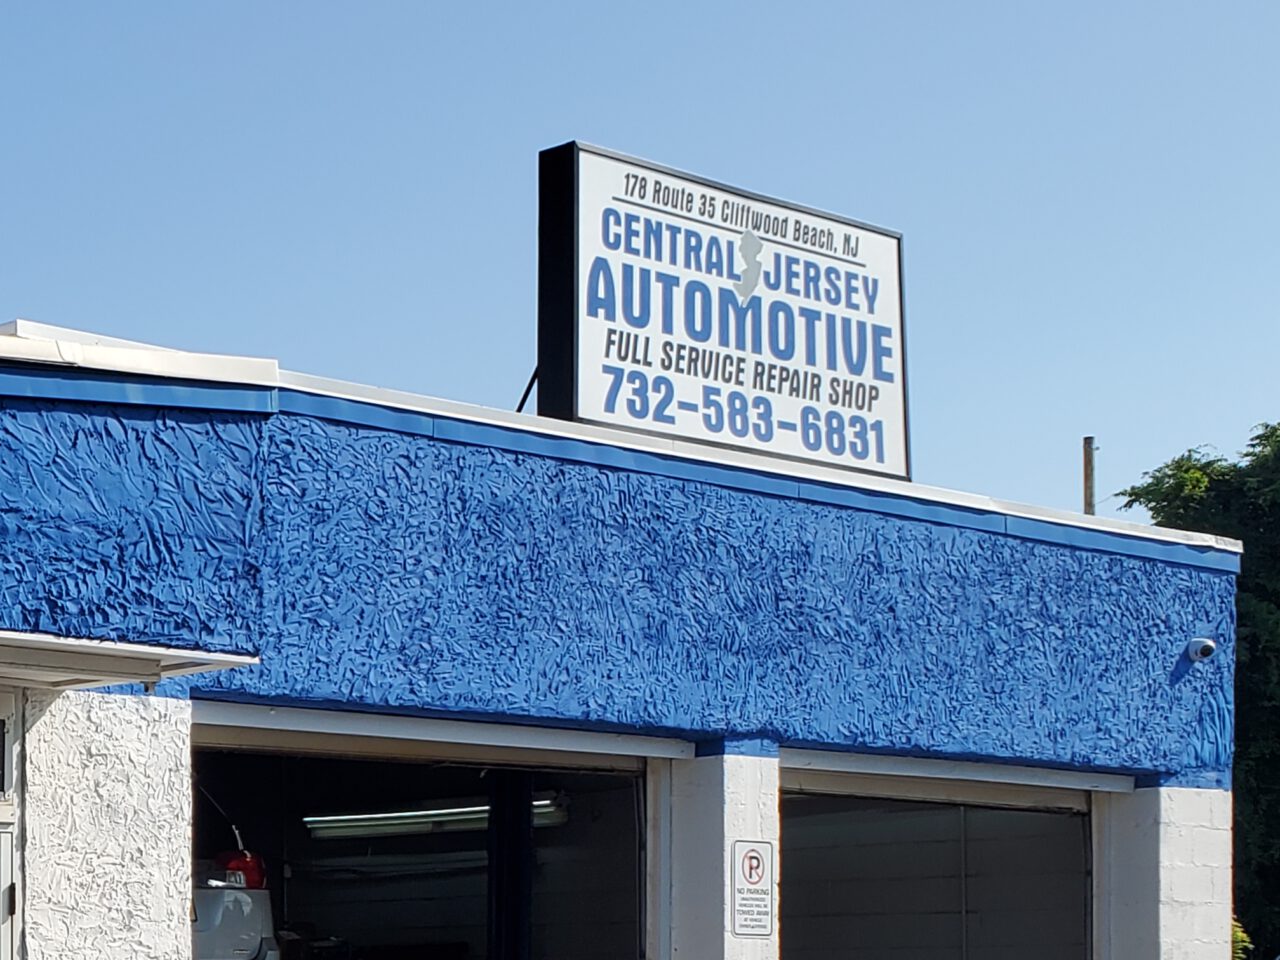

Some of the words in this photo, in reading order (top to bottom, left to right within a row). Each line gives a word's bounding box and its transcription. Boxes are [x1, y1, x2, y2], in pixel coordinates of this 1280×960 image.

[601, 207, 741, 282] CENTRAL
[763, 252, 879, 315] JERSEY
[623, 172, 647, 200] 178
[652, 180, 694, 214] Route
[698, 194, 716, 219] 35
[721, 199, 789, 239] Cliffwood
[793, 219, 837, 254] Beach,
[842, 236, 860, 258] NJ
[586, 256, 895, 384] AUTOMOTIVE
[605, 328, 653, 367] FULL
[660, 340, 746, 386] SERVICE
[753, 361, 821, 402] REPAIR
[828, 377, 880, 412] SHOP
[602, 364, 885, 464] 732-583-6831
